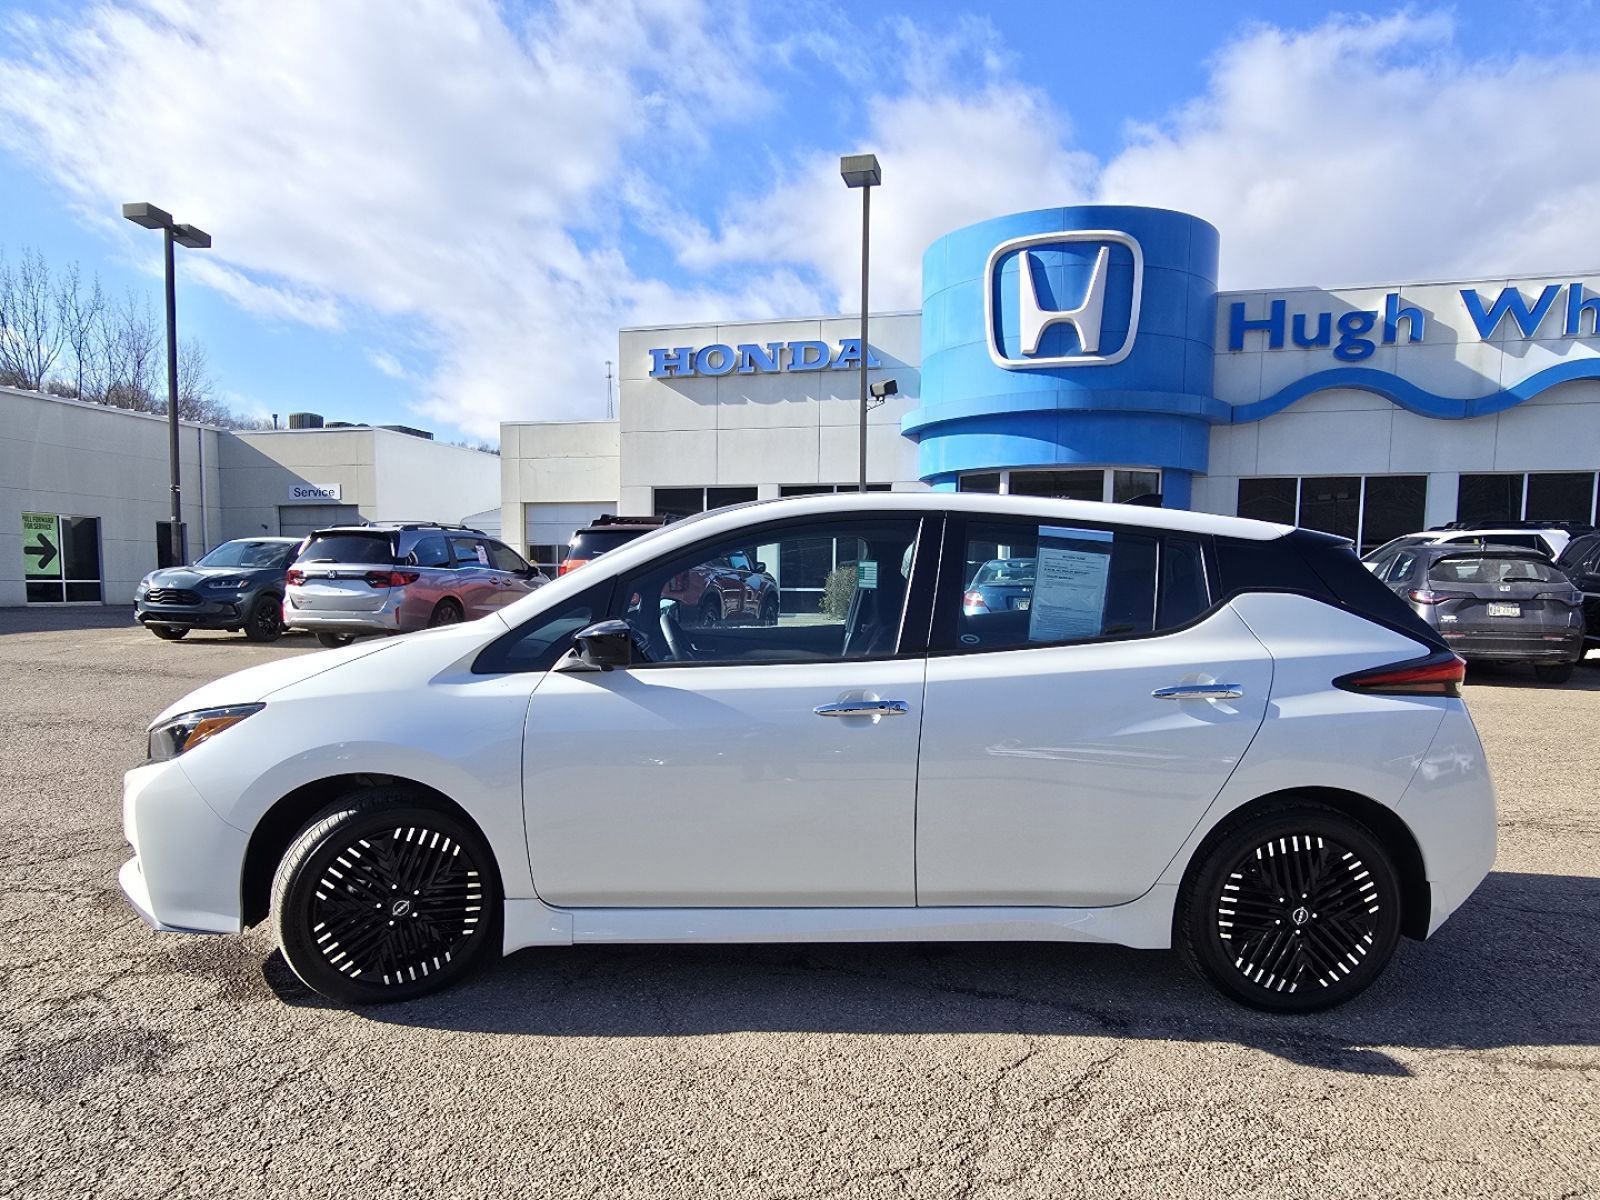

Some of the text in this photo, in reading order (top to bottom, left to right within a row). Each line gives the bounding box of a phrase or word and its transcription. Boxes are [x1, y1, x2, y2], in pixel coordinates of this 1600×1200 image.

[1229, 282, 1600, 361] Hugh Wh
[649, 338, 881, 378] HONDA
[293, 487, 335, 498] Service
